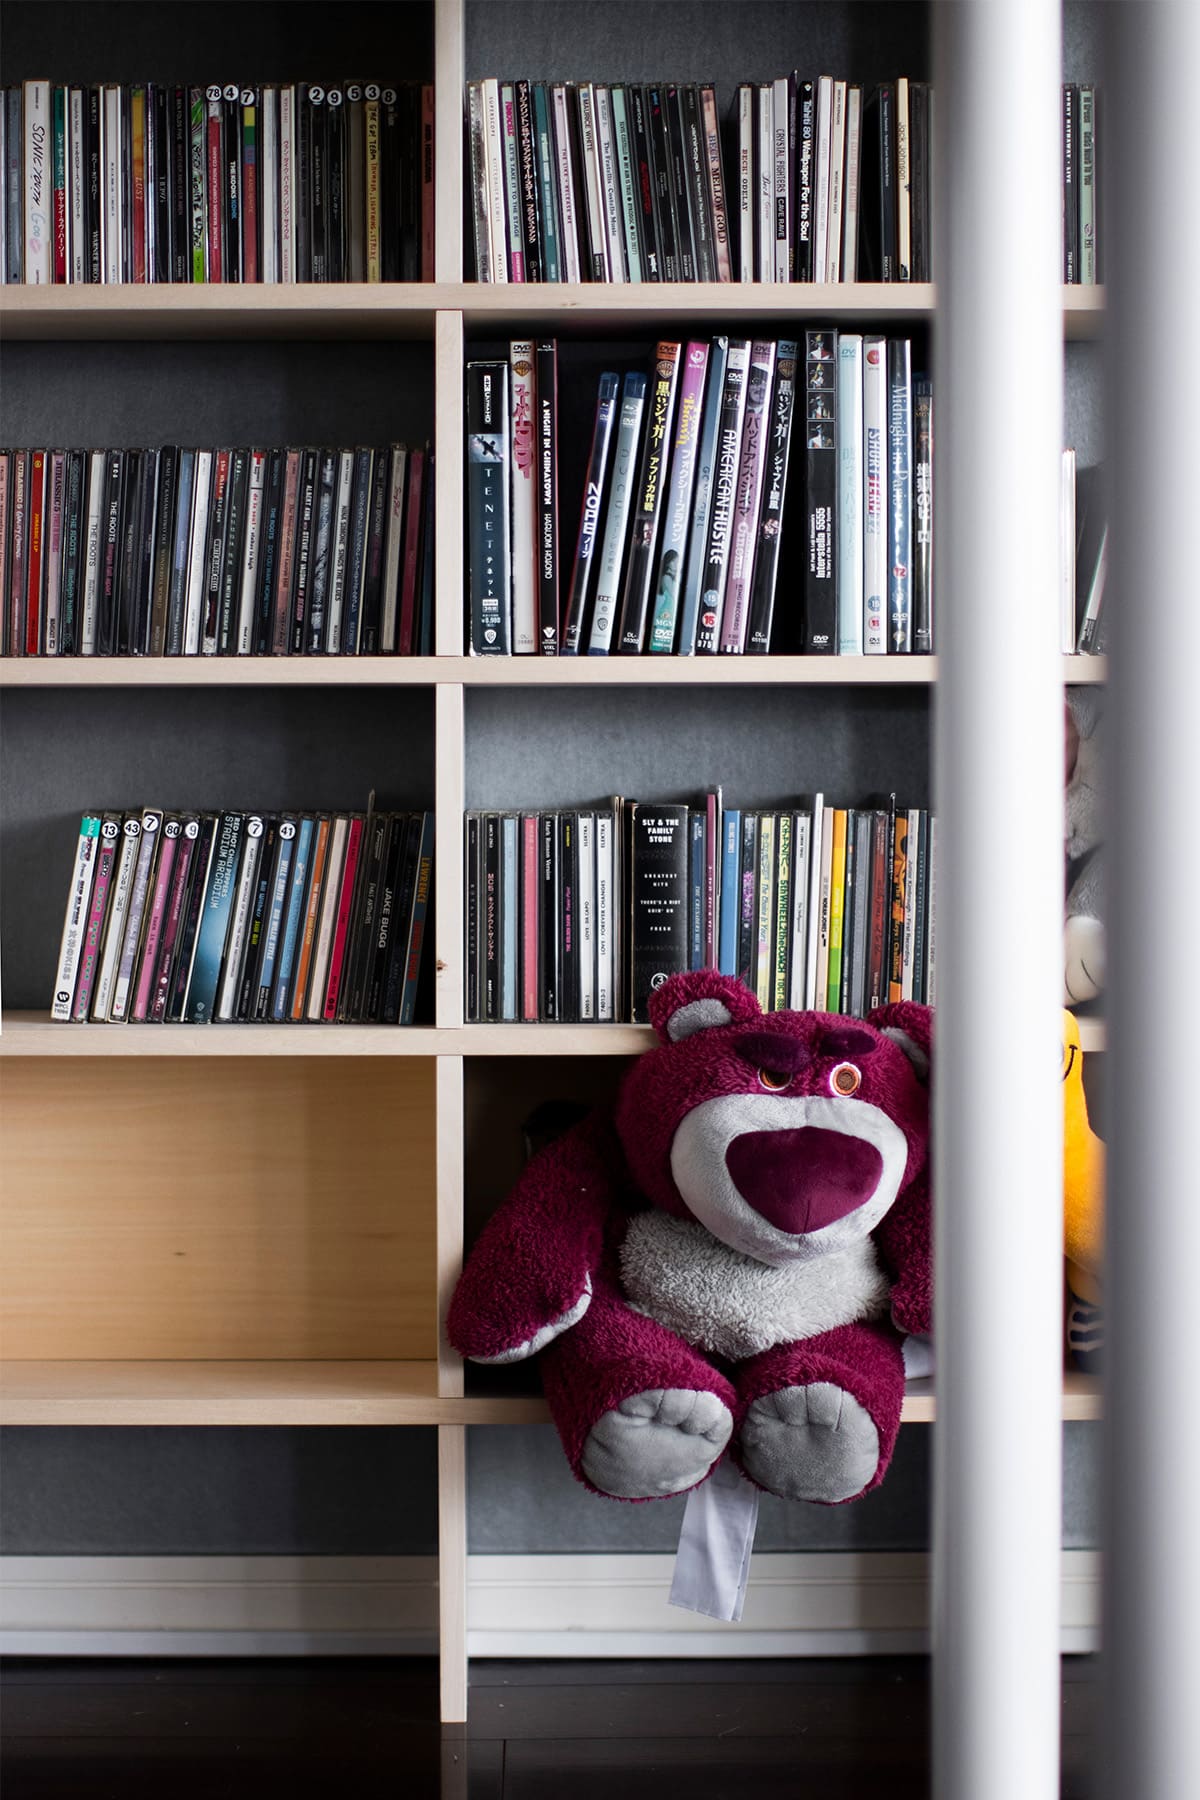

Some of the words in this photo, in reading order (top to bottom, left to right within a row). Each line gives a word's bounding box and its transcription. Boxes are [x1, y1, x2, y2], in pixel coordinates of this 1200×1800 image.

[208, 87, 220, 100] 78
[583, 99, 592, 129] MAURICE
[803, 100, 812, 125] Tahiti
[31, 124, 45, 165] SONIC
[776, 129, 785, 158] CRYSTAL
[803, 126, 811, 139] 80
[708, 135, 718, 163] BECK
[800, 140, 811, 185] Wallpaper
[776, 160, 786, 193] FIGHTERS
[136, 177, 144, 202] LUST
[711, 168, 723, 211] MELLOW
[801, 187, 809, 201] For
[801, 204, 809, 218] the
[716, 214, 726, 243] GOLD
[800, 220, 809, 240] Soul
[543, 411, 552, 438] NIGHT
[890, 384, 908, 447] Midnight
[544, 439, 552, 449] IN
[544, 450, 552, 505] CHINATOWN
[715, 429, 737, 509] AMERICAN
[54, 460, 63, 505] JURASSIC
[110, 501, 118, 516] THE
[340, 506, 348, 520] NINA
[484, 468, 494, 549] TENET
[582, 482, 600, 535] NOPE
[816, 507, 826, 531] 5555
[90, 524, 98, 540] THE
[108, 517, 117, 543] ROOTS
[338, 522, 346, 545] SIMONE
[709, 510, 727, 565] HUSTLE
[89, 541, 98, 567] ROOTS
[337, 548, 345, 567] SINGS
[816, 532, 826, 578] Interstella
[336, 569, 344, 580] THE
[335, 582, 343, 602] BLUES
[704, 615, 715, 625] 15
[103, 825, 116, 836] 13
[125, 822, 140, 834] 43
[166, 825, 180, 836] 80
[219, 816, 234, 857] STADIUM
[233, 818, 241, 831] RED
[280, 825, 295, 837] 41
[230, 832, 238, 848] HOT
[227, 849, 237, 866] CHILI
[279, 860, 289, 877] WILL
[210, 859, 224, 908] ARCADIUM
[222, 867, 233, 897] PEPPERS
[275, 879, 286, 901] SMITH
[417, 857, 431, 903] LAWRENCE
[382, 887, 394, 915] JAKE
[378, 917, 391, 948] BUGG
